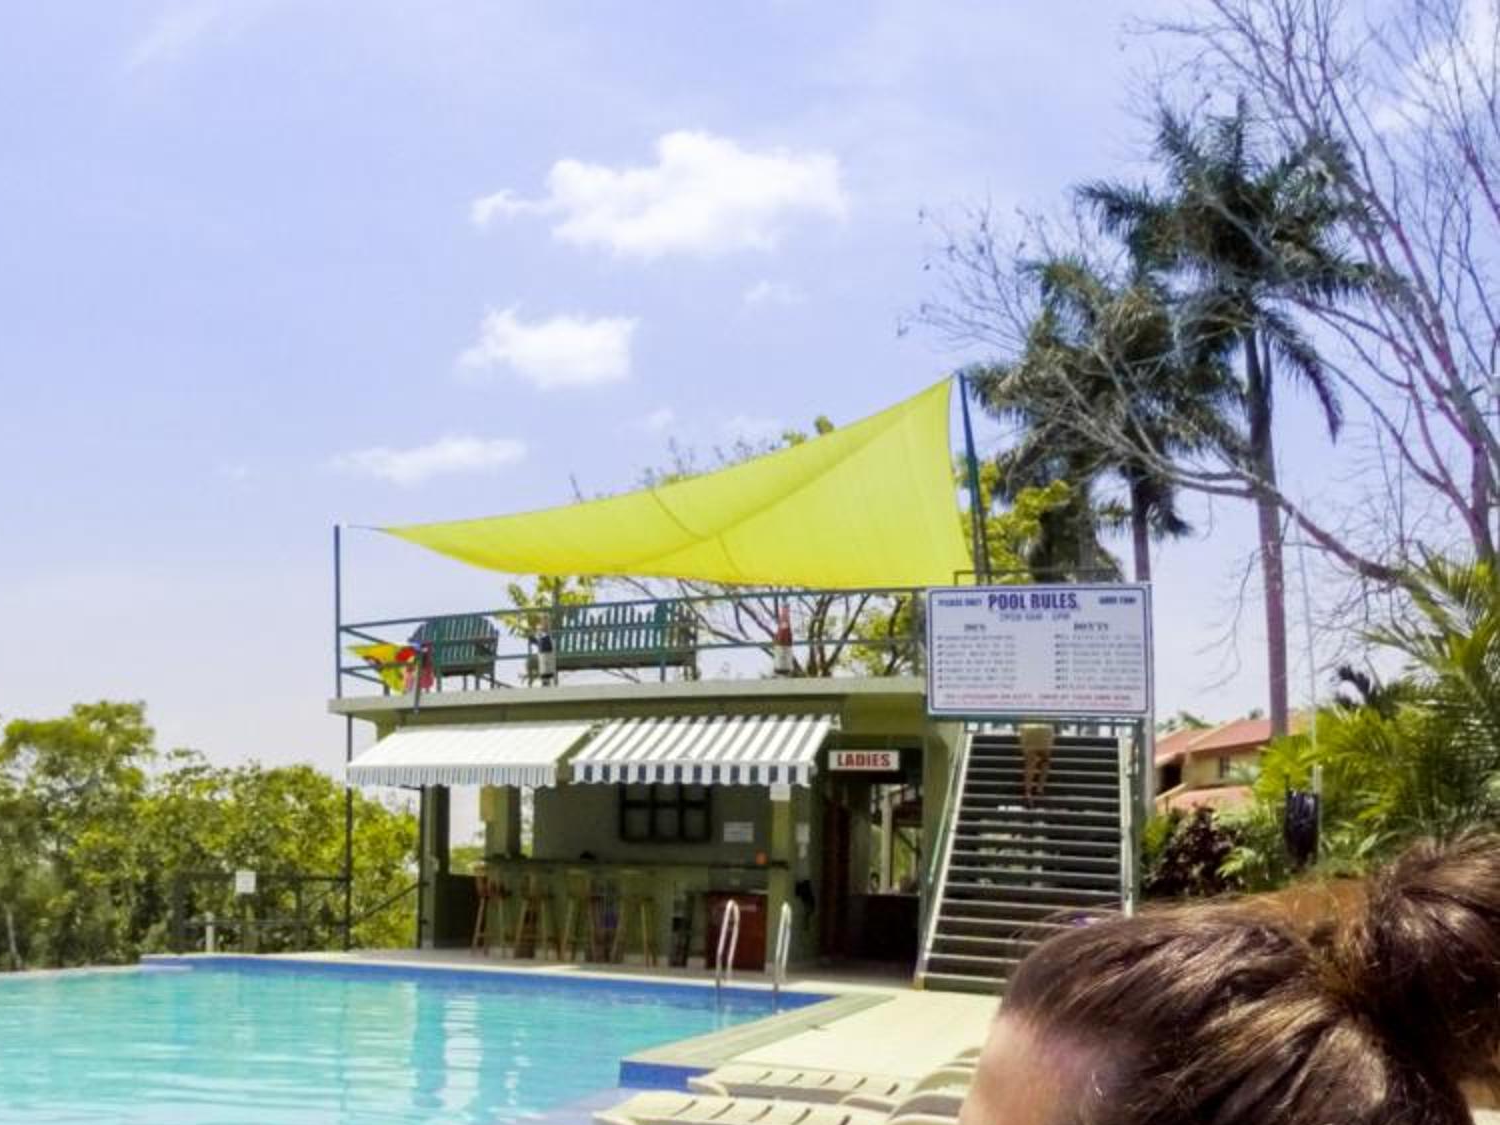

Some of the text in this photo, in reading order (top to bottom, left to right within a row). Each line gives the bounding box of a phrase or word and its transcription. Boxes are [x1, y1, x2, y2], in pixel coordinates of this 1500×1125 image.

[988, 593, 1026, 610] POOL
[1031, 592, 1077, 609] RULES
[837, 753, 891, 767] LADIES
